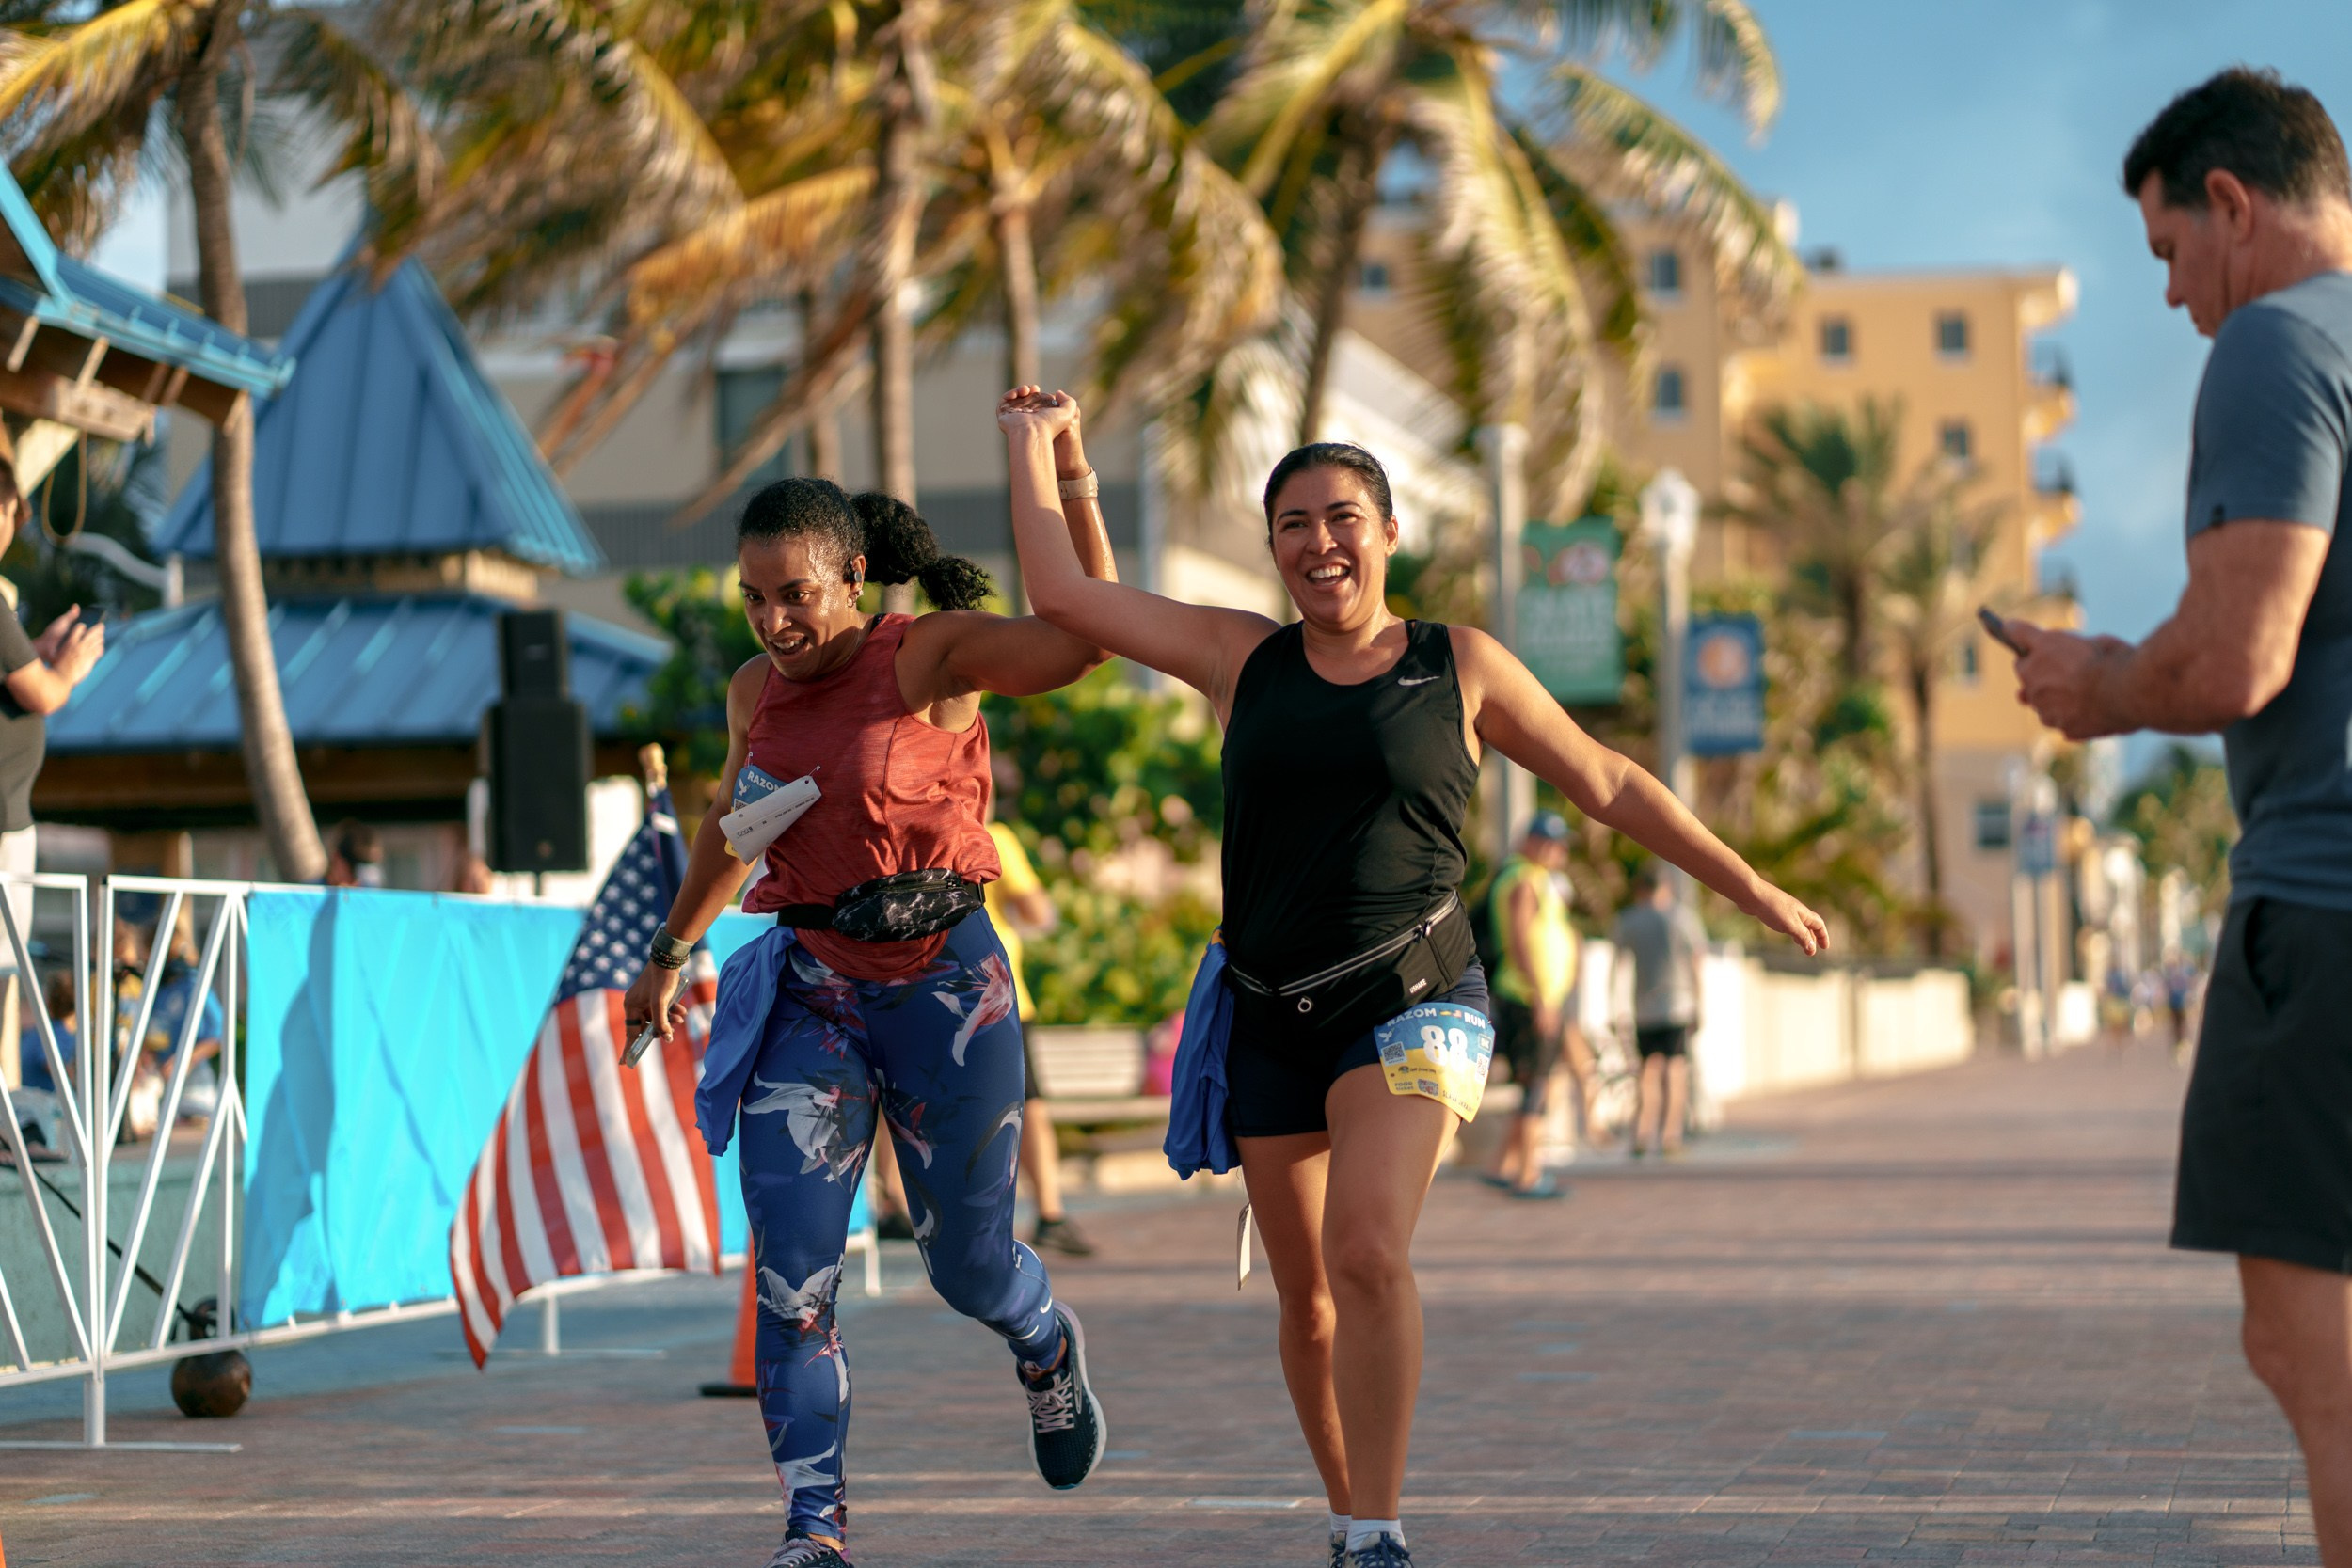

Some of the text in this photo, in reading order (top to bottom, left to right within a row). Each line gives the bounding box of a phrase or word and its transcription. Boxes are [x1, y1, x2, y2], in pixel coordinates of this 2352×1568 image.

[1387, 1008, 1486, 1029] RAZOM RUN
[1420, 1025, 1469, 1072] 88
